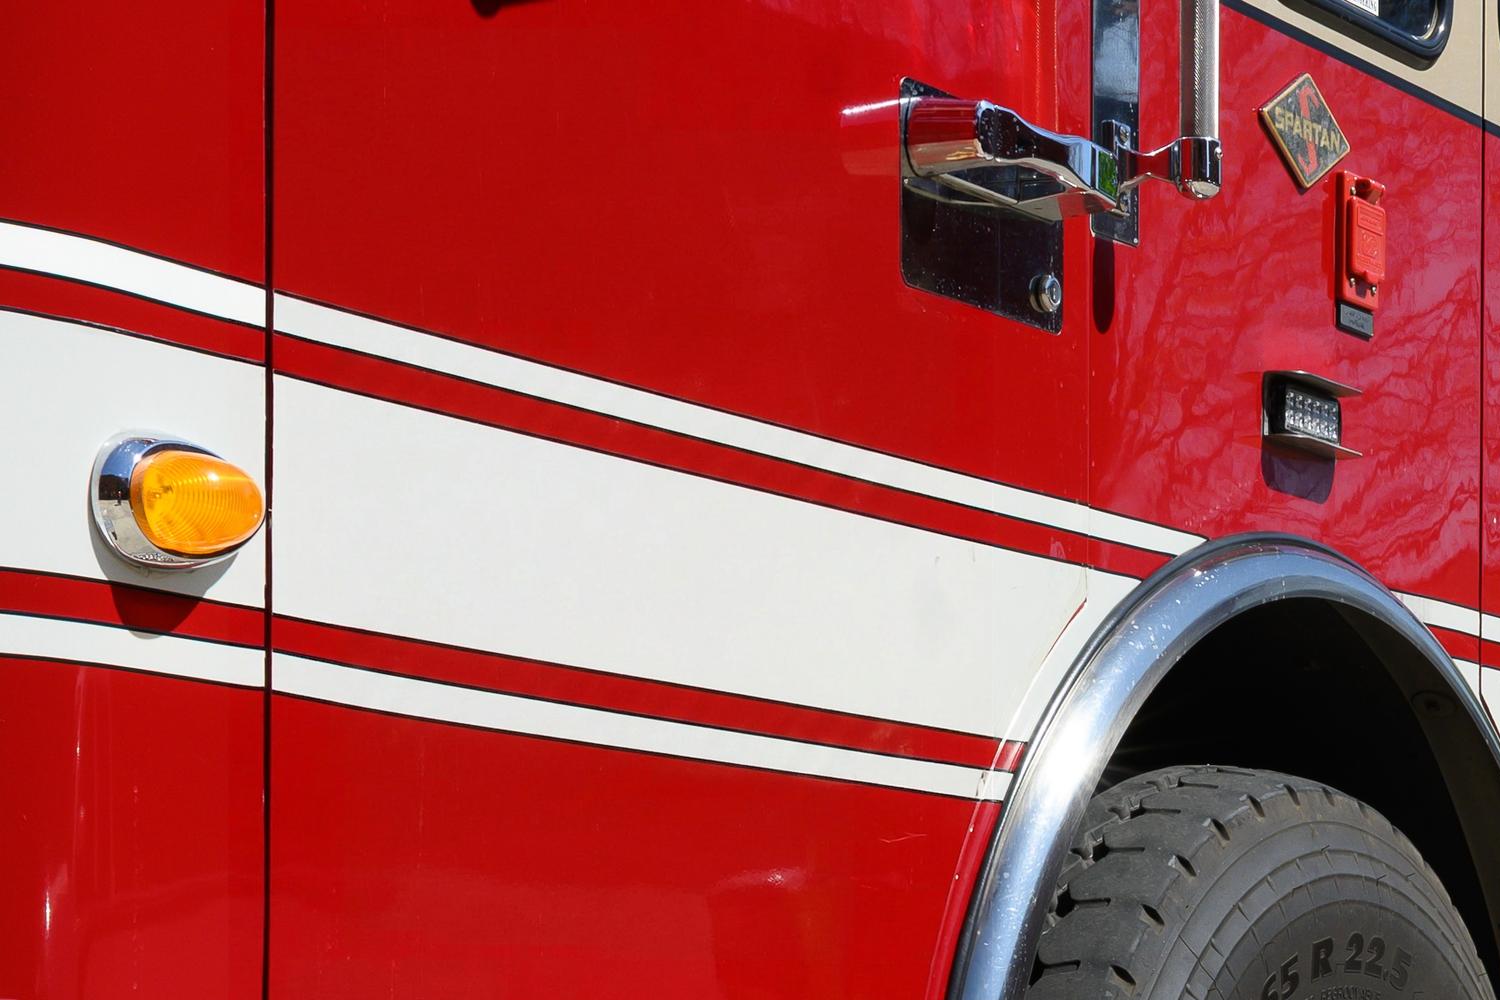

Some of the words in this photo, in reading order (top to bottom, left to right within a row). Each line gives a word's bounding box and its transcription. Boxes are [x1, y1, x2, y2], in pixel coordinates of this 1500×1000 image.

[1273, 105, 1342, 152] SPARTAN
[1309, 936, 1335, 985] R
[1343, 932, 1413, 992] 22.5
